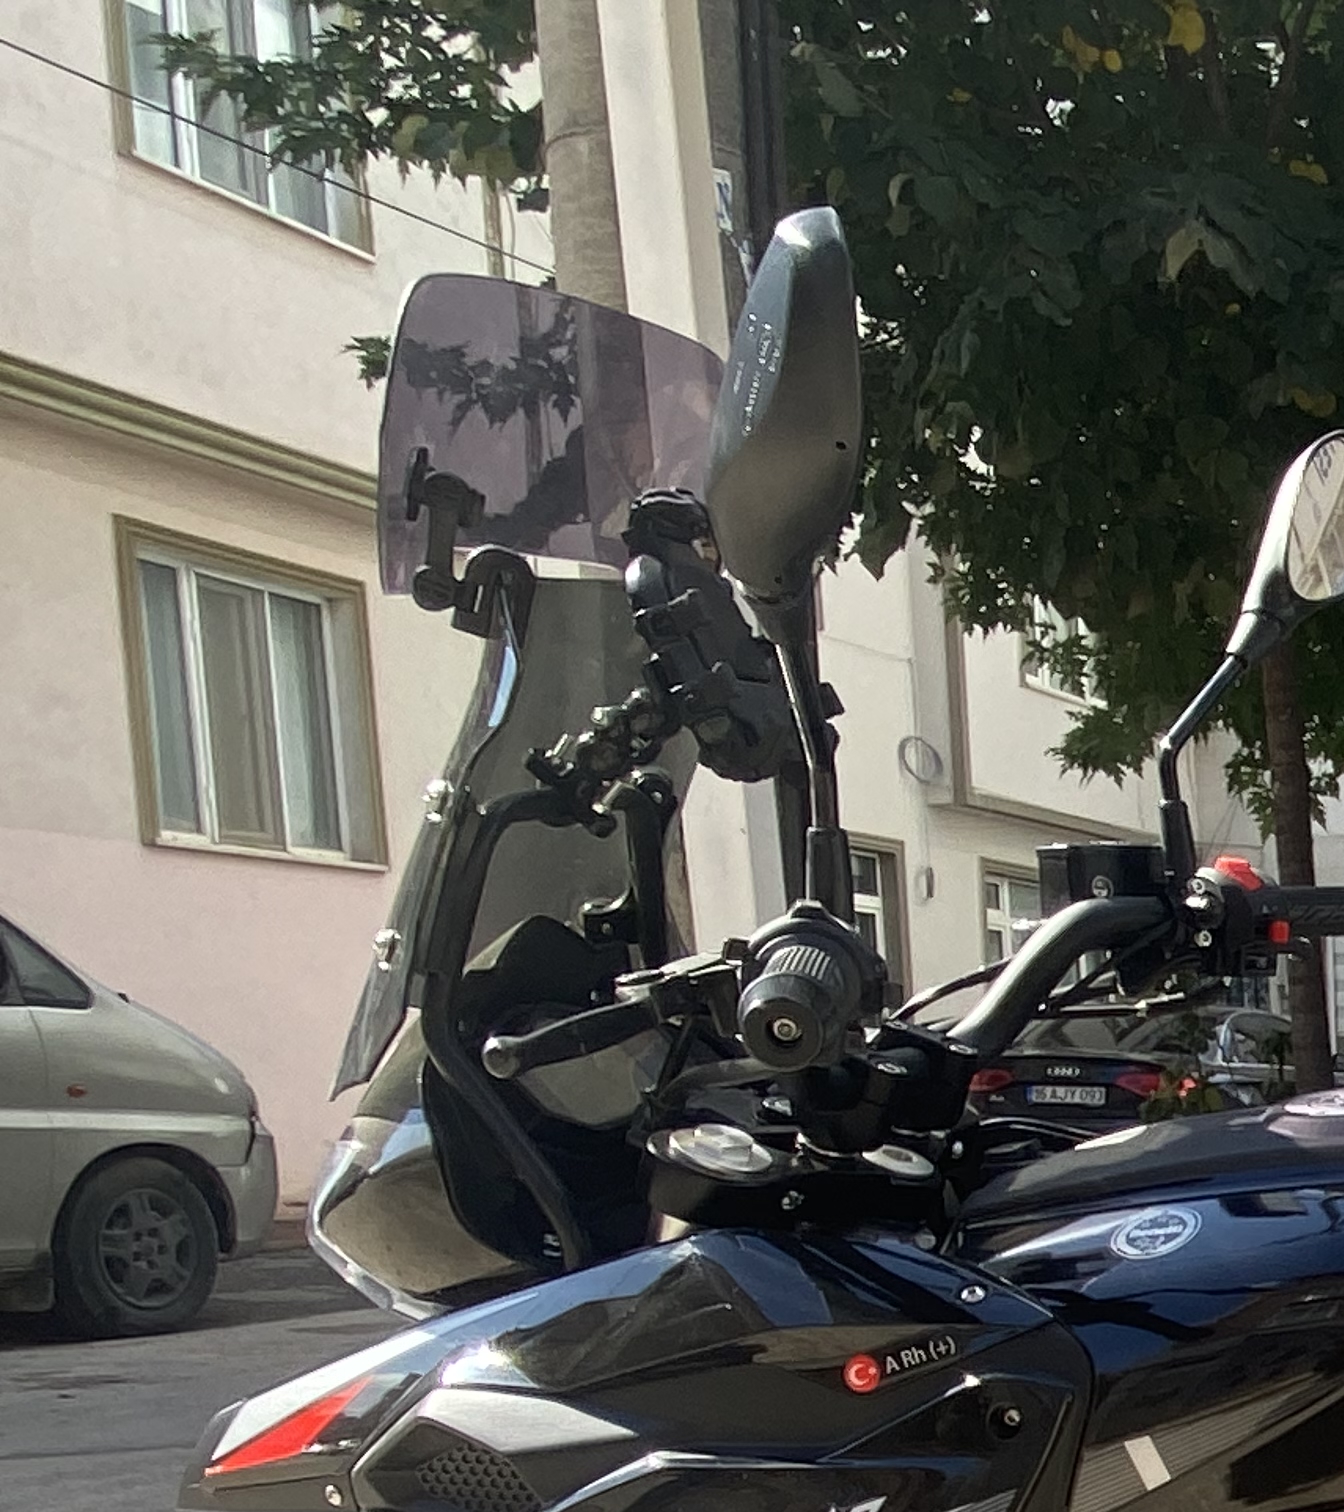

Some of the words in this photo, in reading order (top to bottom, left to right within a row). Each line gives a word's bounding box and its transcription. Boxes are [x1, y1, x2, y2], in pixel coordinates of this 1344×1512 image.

[885, 1355, 900, 1375] A
[900, 1346, 928, 1369] Rh
[928, 1335, 957, 1360] (+)
